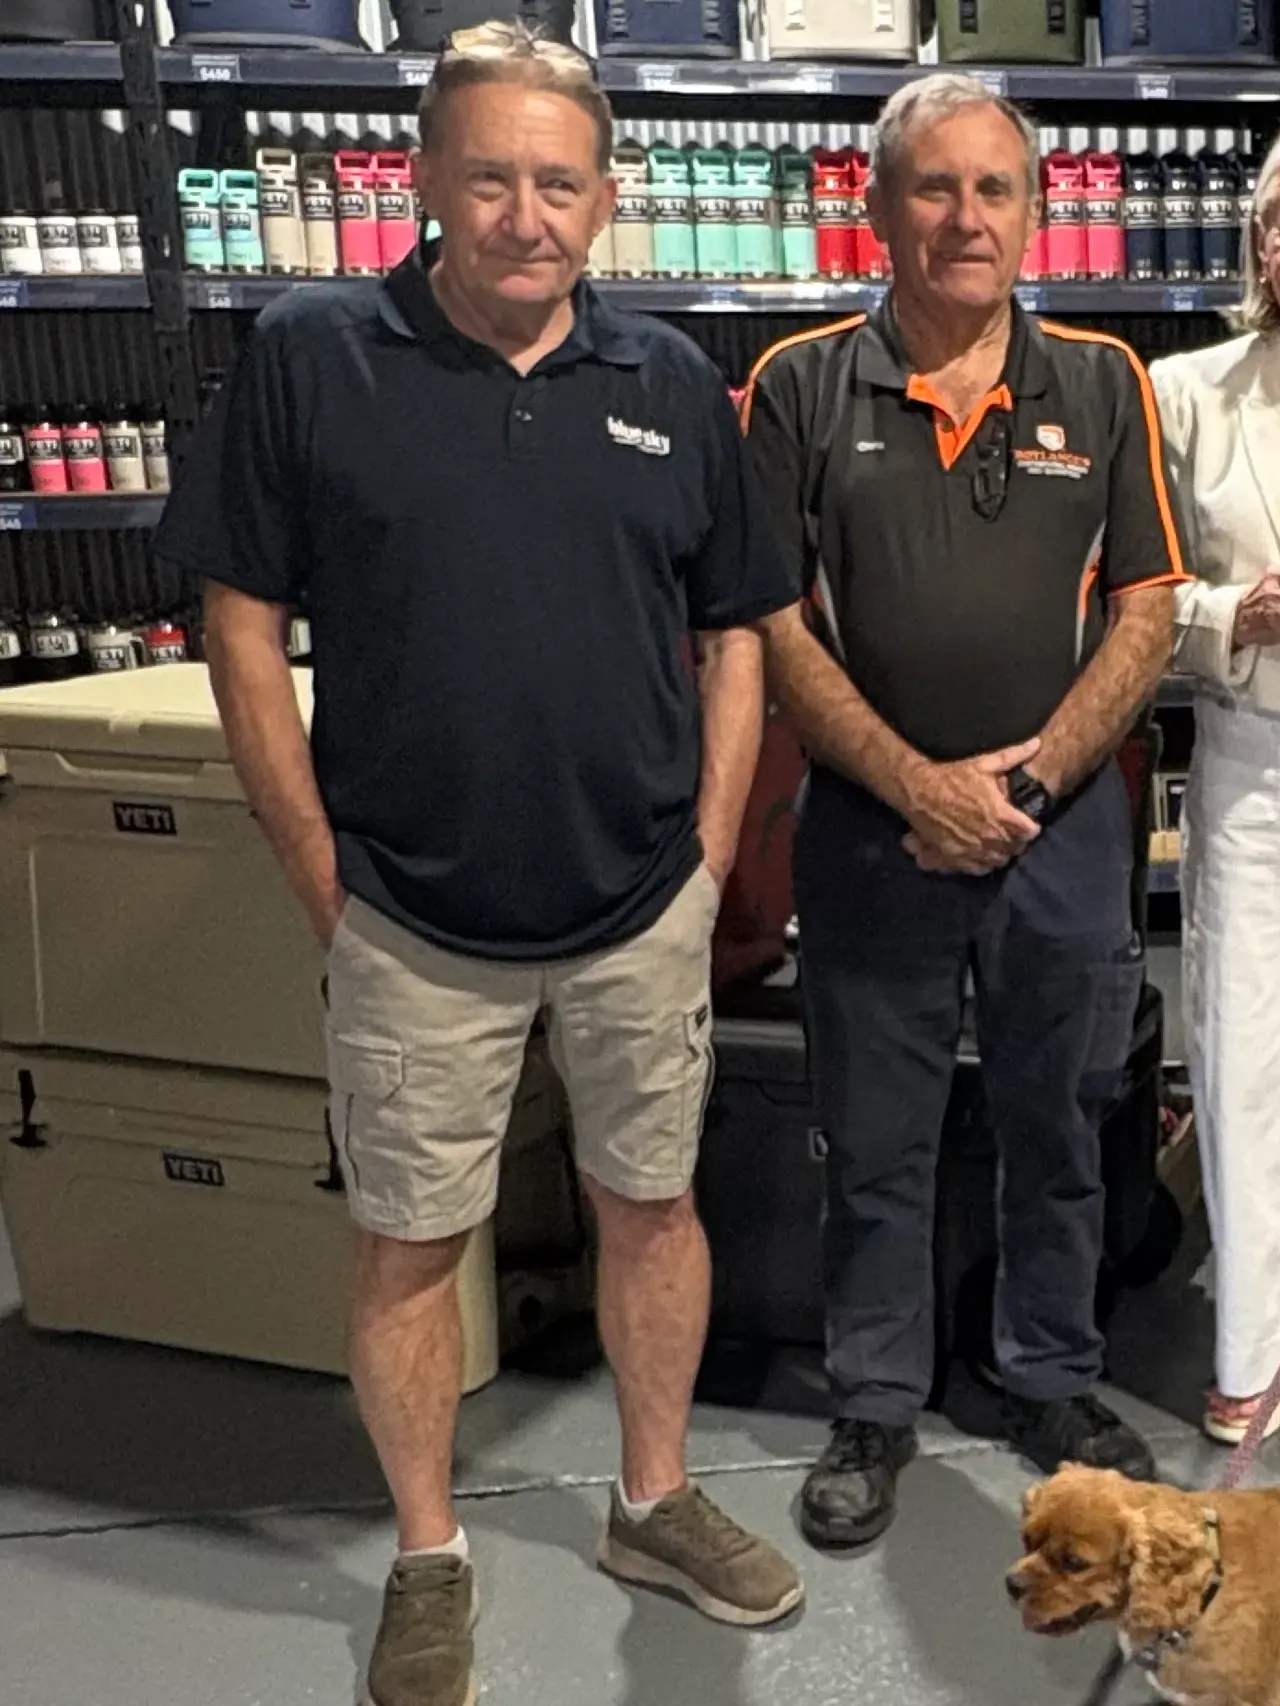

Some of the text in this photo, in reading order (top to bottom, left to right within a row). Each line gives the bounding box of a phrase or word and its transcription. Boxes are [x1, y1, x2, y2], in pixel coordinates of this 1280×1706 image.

[1048, 200, 1079, 212] YETI
[1087, 200, 1117, 212] YETI
[1127, 200, 1158, 212] YETI
[1165, 200, 1196, 212] YETI
[1202, 200, 1232, 212] YETI
[117, 806, 171, 831] YETI
[168, 1158, 219, 1183] YETI
